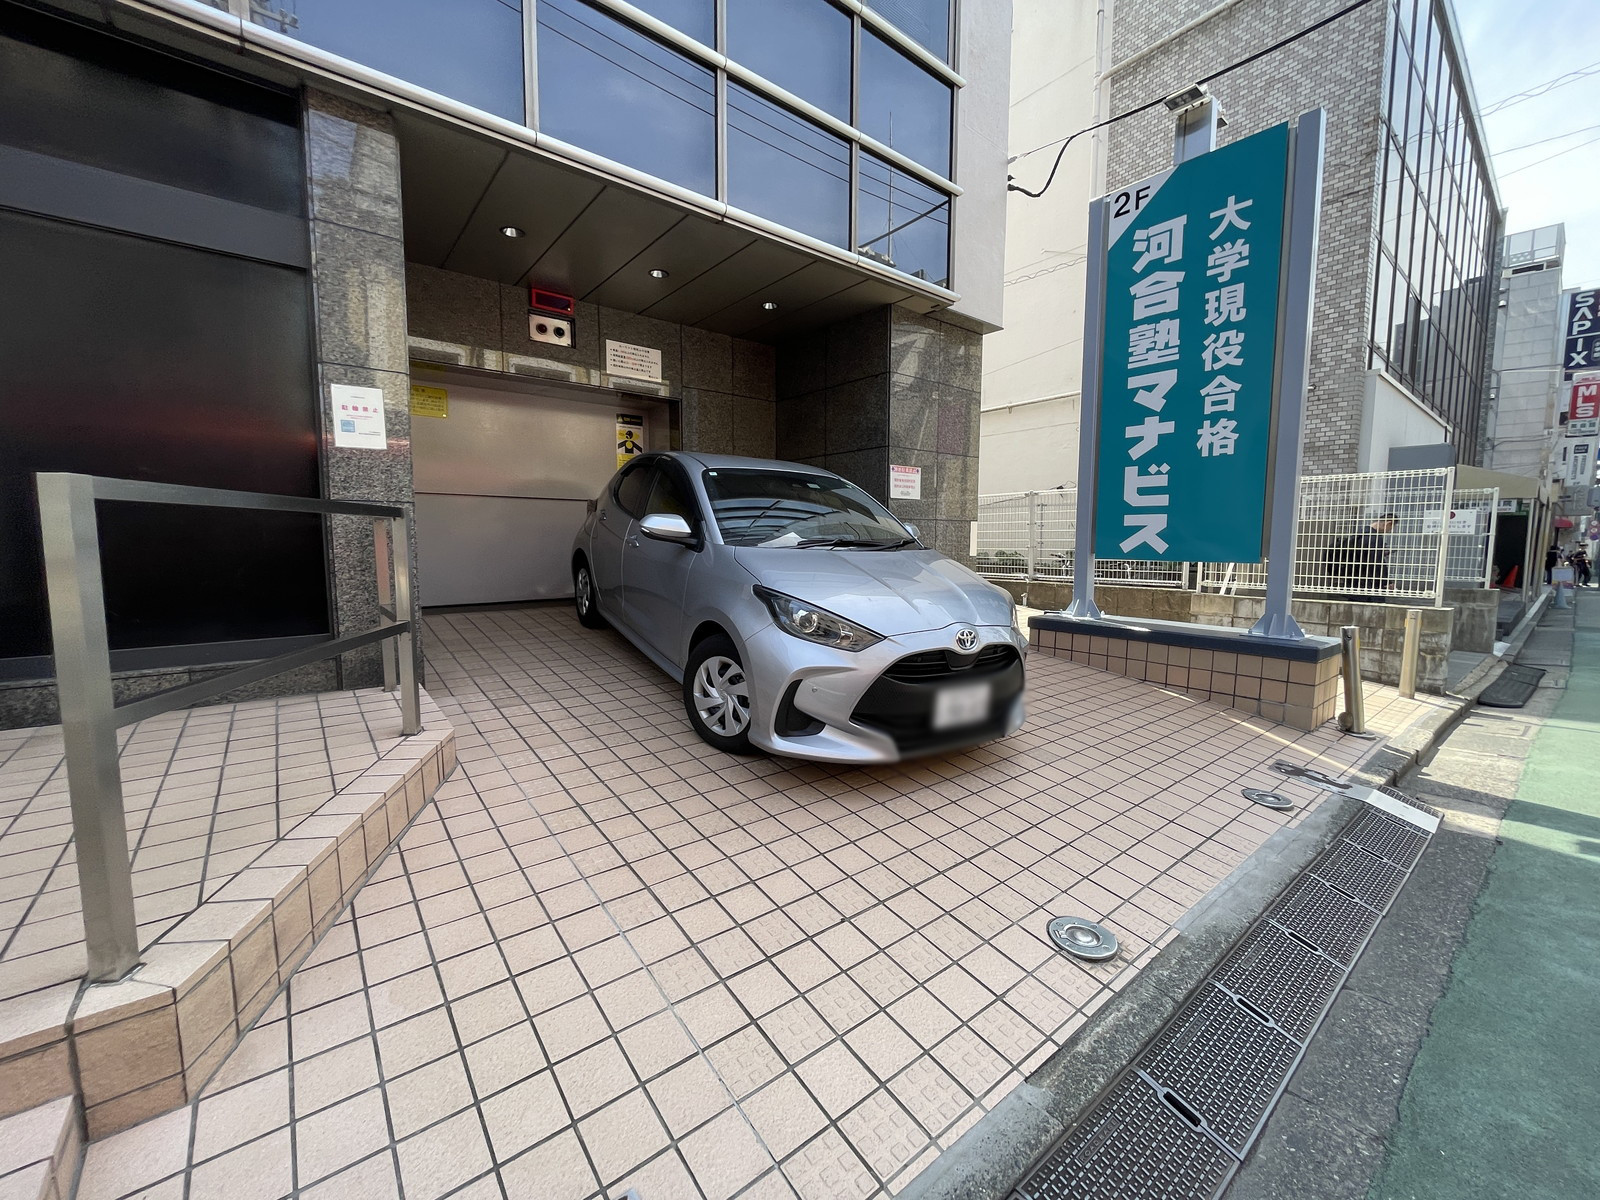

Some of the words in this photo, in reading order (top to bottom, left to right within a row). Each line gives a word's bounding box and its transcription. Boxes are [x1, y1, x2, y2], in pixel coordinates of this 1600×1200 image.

[1112, 185, 1152, 219] 2F
[1196, 195, 1254, 458] 大学現役合格
[1569, 291, 1595, 367] SAPIX
[1119, 214, 1188, 555] 河合塾マナビス
[1576, 385, 1597, 418] MLS
